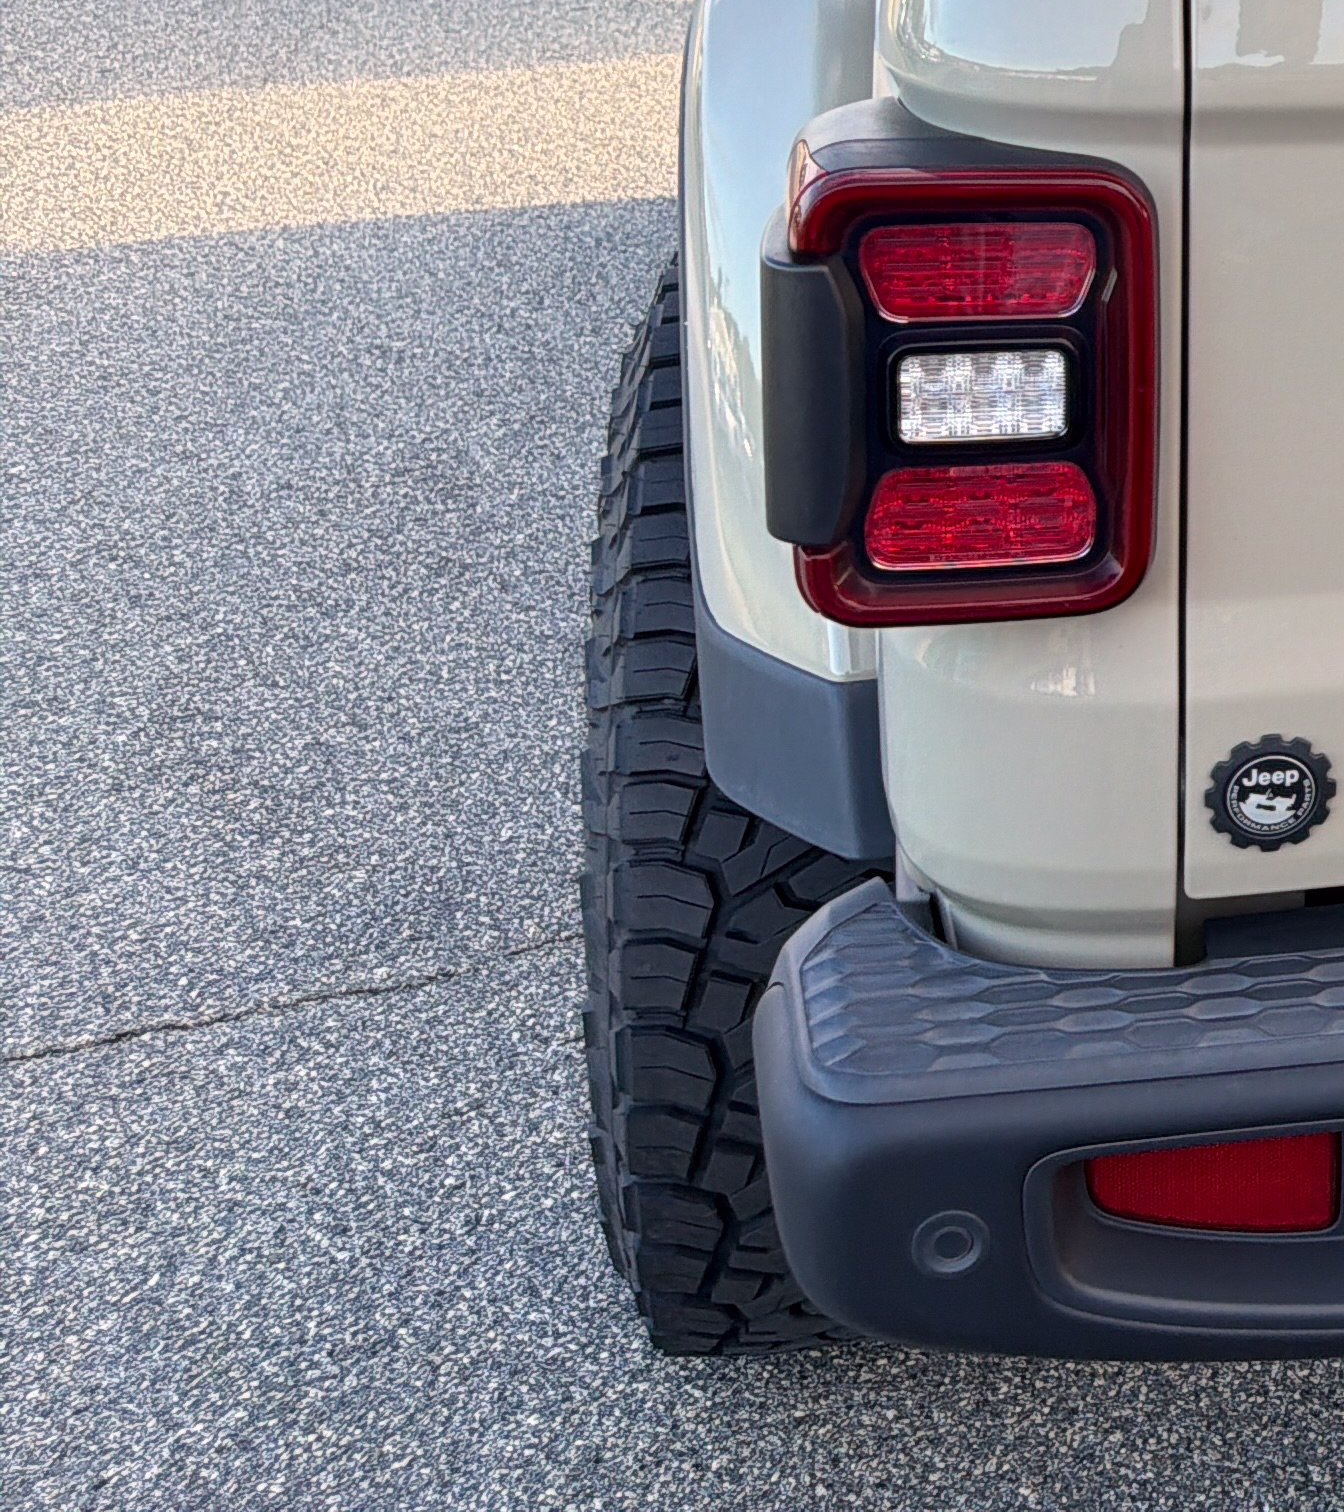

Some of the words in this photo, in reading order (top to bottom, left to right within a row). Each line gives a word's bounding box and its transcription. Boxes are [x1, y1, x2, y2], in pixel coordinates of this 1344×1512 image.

[1241, 768, 1300, 787] Jeep
[1230, 785, 1297, 831] PERFORMANCE
[1296, 778, 1312, 817] PARTS
